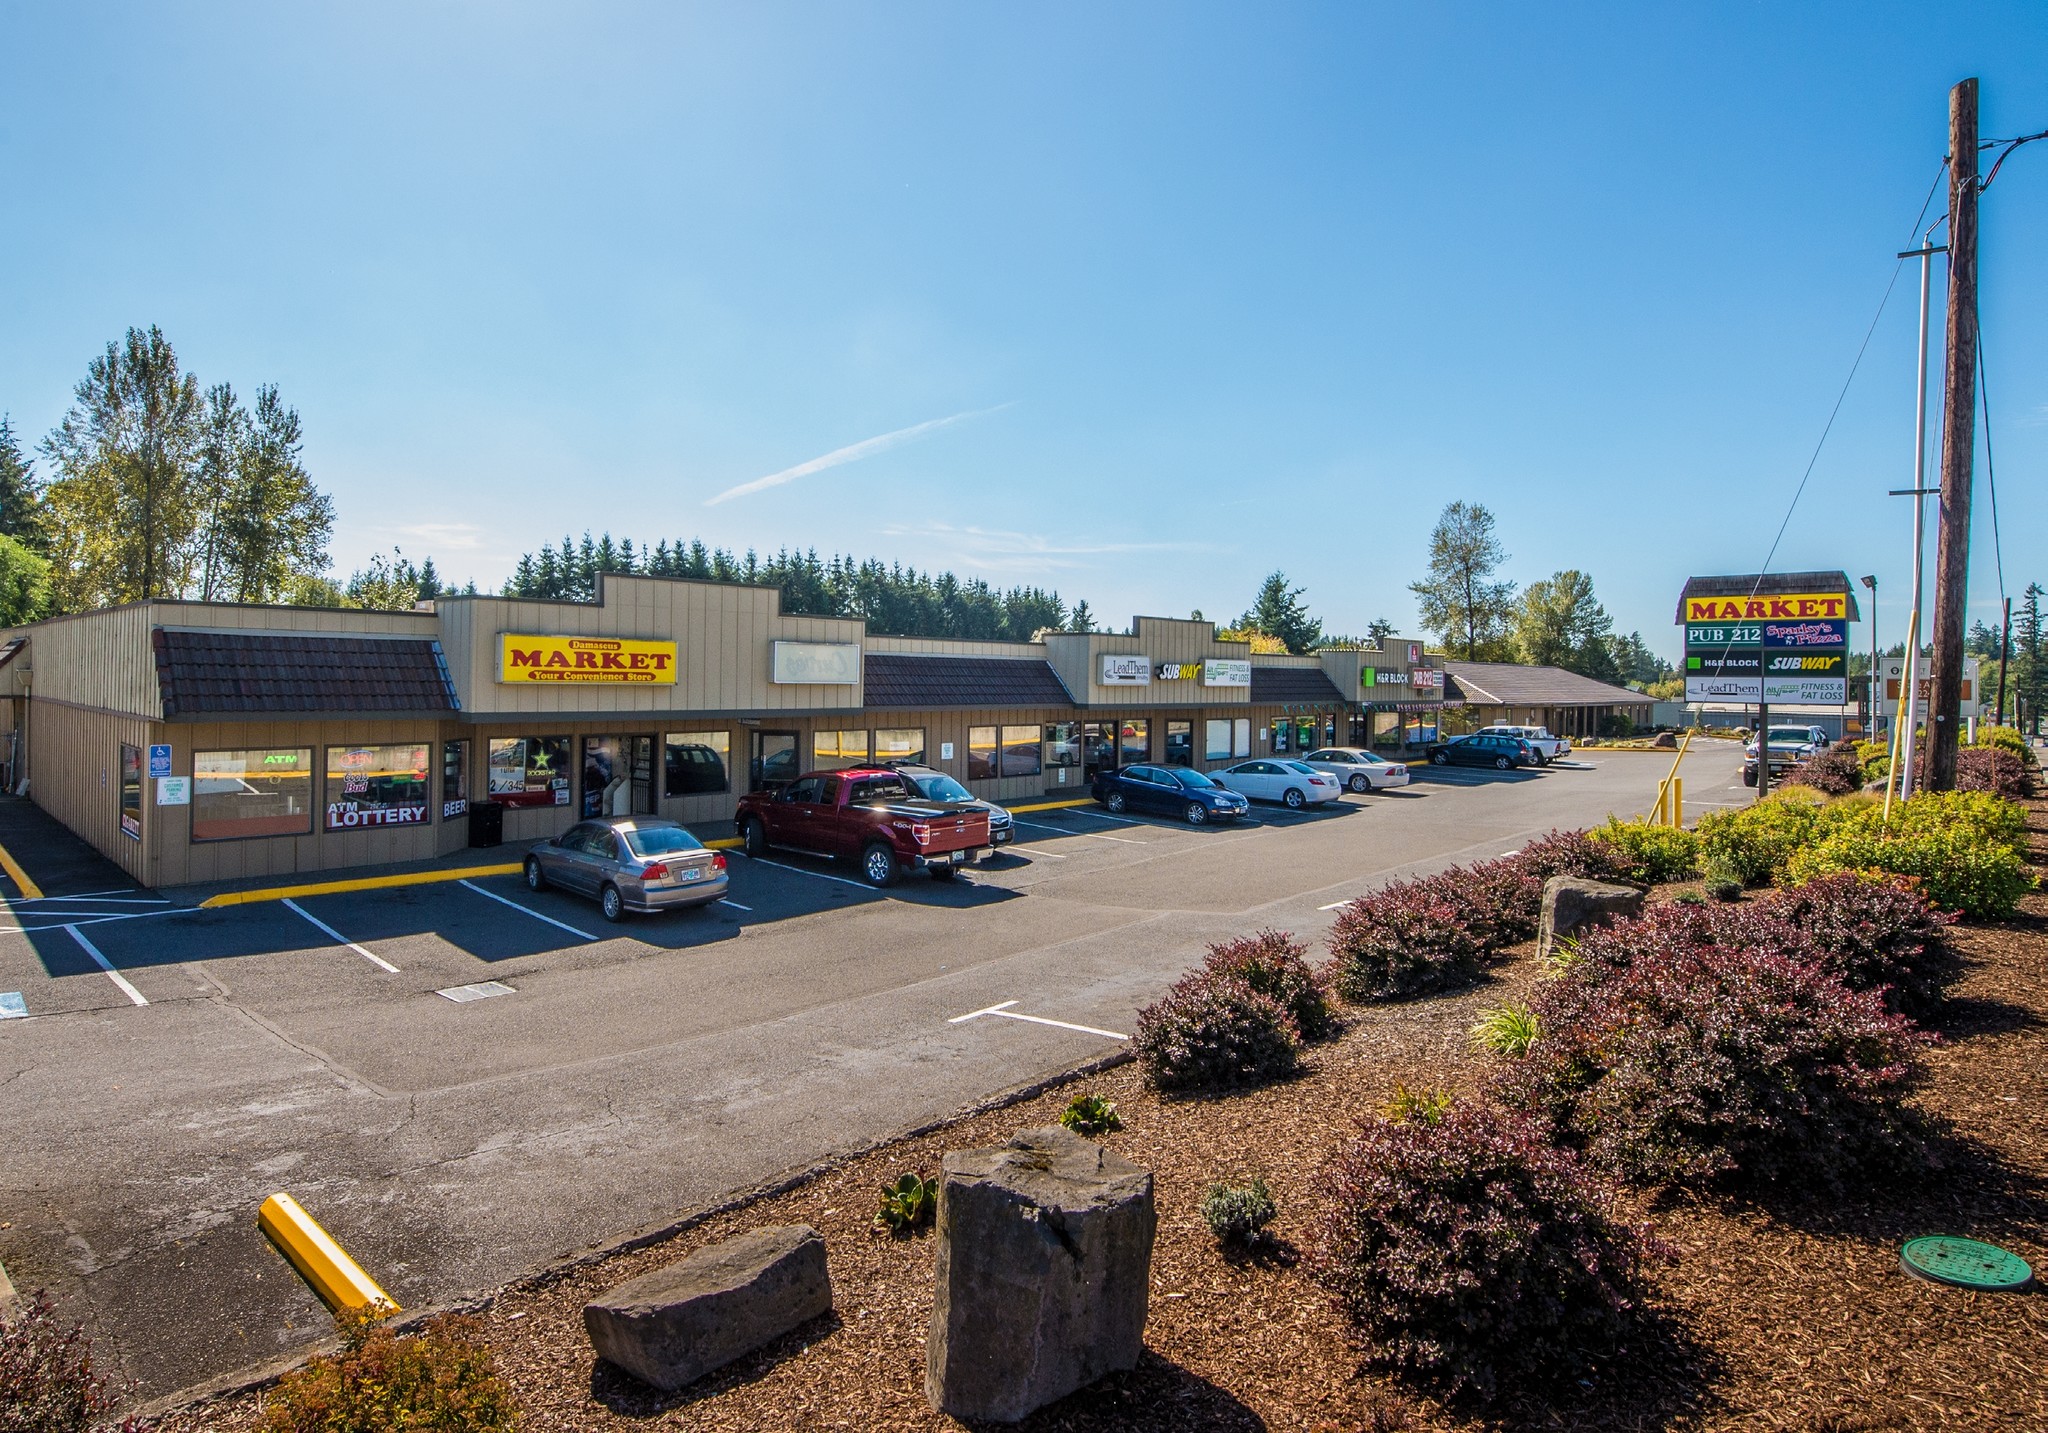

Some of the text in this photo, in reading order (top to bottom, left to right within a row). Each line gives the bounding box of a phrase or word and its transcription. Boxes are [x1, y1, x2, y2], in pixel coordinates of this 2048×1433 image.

[1690, 599, 1843, 620] MARKET
[1689, 628, 1761, 641] PUB 212
[1766, 623, 1832, 638] Sparky's
[572, 640, 618, 650] Damascus
[1796, 634, 1843, 644] Pizza
[510, 650, 672, 669] MARKET
[1726, 659, 1759, 667] BLOCK
[1768, 656, 1841, 670] SUBWAY
[1113, 660, 1149, 675] LeadThem
[1159, 663, 1202, 680] SUBWAY
[1229, 664, 1246, 672] FITNESS
[534, 671, 652, 681] Your Convenience Store
[1229, 674, 1250, 682] FAT LOSS
[1376, 672, 1409, 684] H&R BLOCK
[1413, 671, 1423, 685] PUB
[1423, 671, 1433, 685] 212
[1700, 682, 1759, 693] LeadThem
[1801, 683, 1835, 691] FITNESS
[1801, 691, 1843, 700] FAT LOSS
[340, 753, 373, 766] OPEN
[345, 783, 367, 793] Bud
[328, 802, 358, 813] ATM
[444, 800, 466, 817] BEER
[332, 807, 426, 828] LOTTERY
